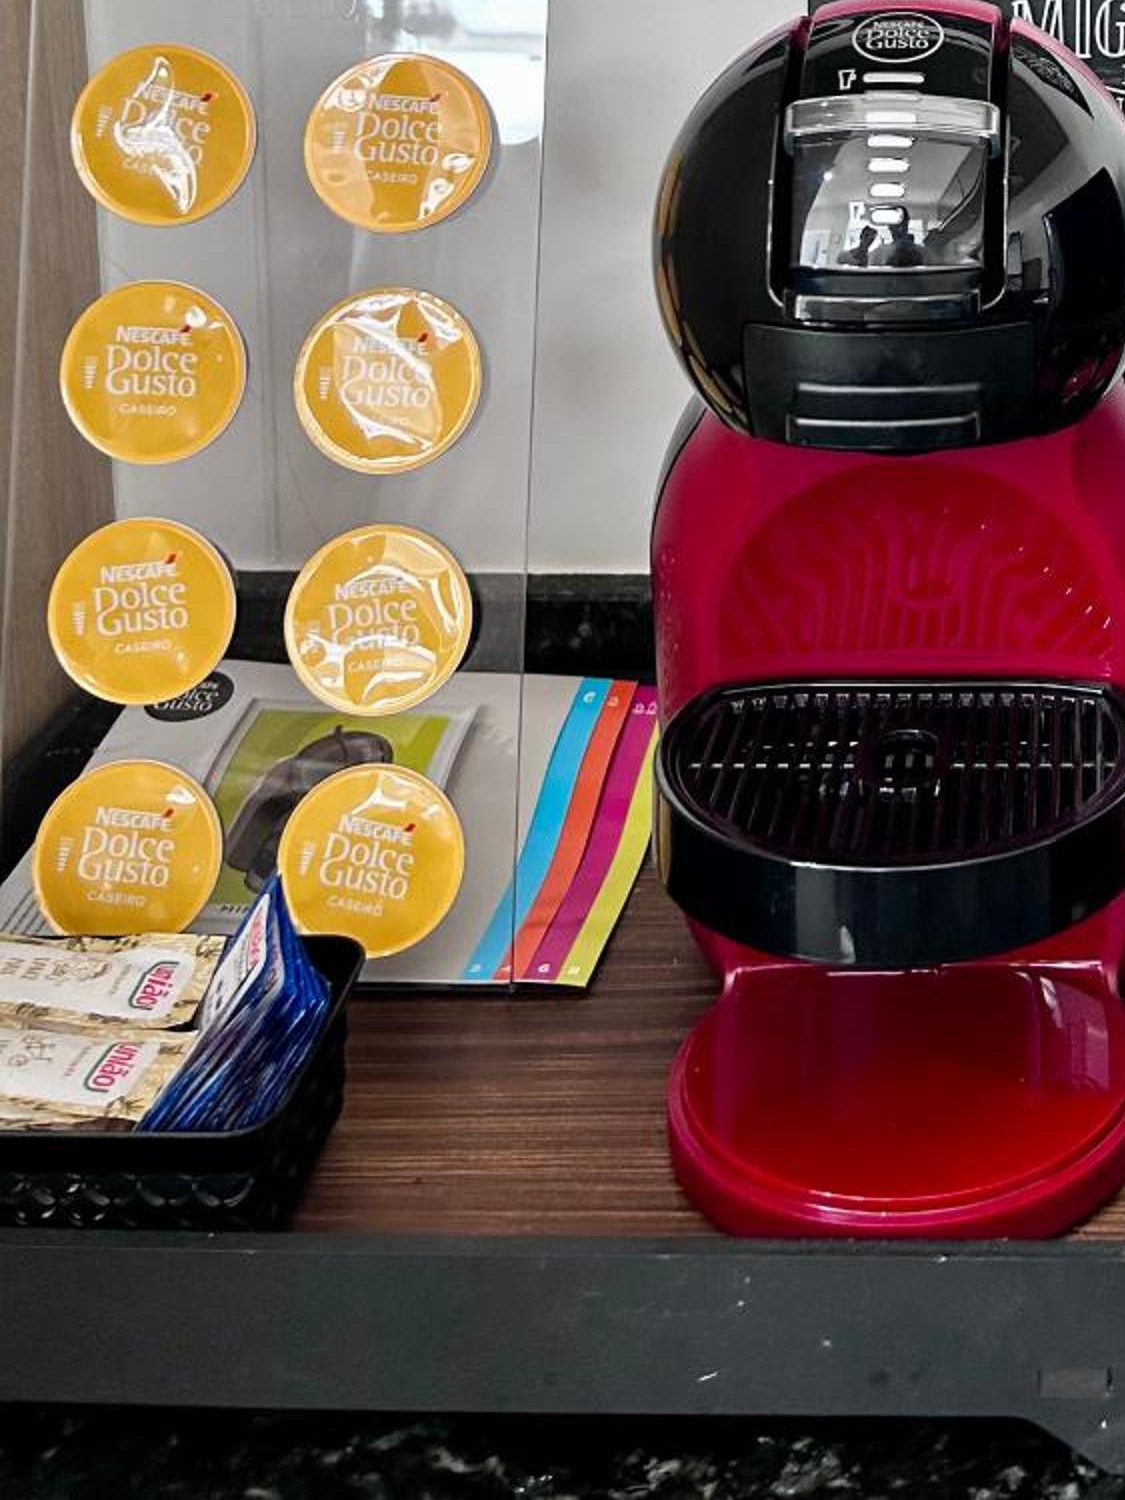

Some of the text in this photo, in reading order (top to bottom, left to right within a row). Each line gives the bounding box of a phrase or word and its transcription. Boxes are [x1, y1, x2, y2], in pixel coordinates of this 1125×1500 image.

[865, 38, 930, 50] Gusto
[355, 111, 442, 143] Dolce
[354, 136, 439, 166] Gusto
[106, 345, 198, 374] Dolce
[105, 370, 197, 397] Gusto
[340, 381, 431, 407] Gusto
[93, 582, 187, 612] Dolce
[97, 607, 189, 636] Gusto
[325, 598, 417, 629] Dolce
[85, 825, 175, 863] Dolce
[323, 833, 415, 877] Dolce
[78, 852, 169, 887] Gusto
[319, 859, 409, 900] Gusto
